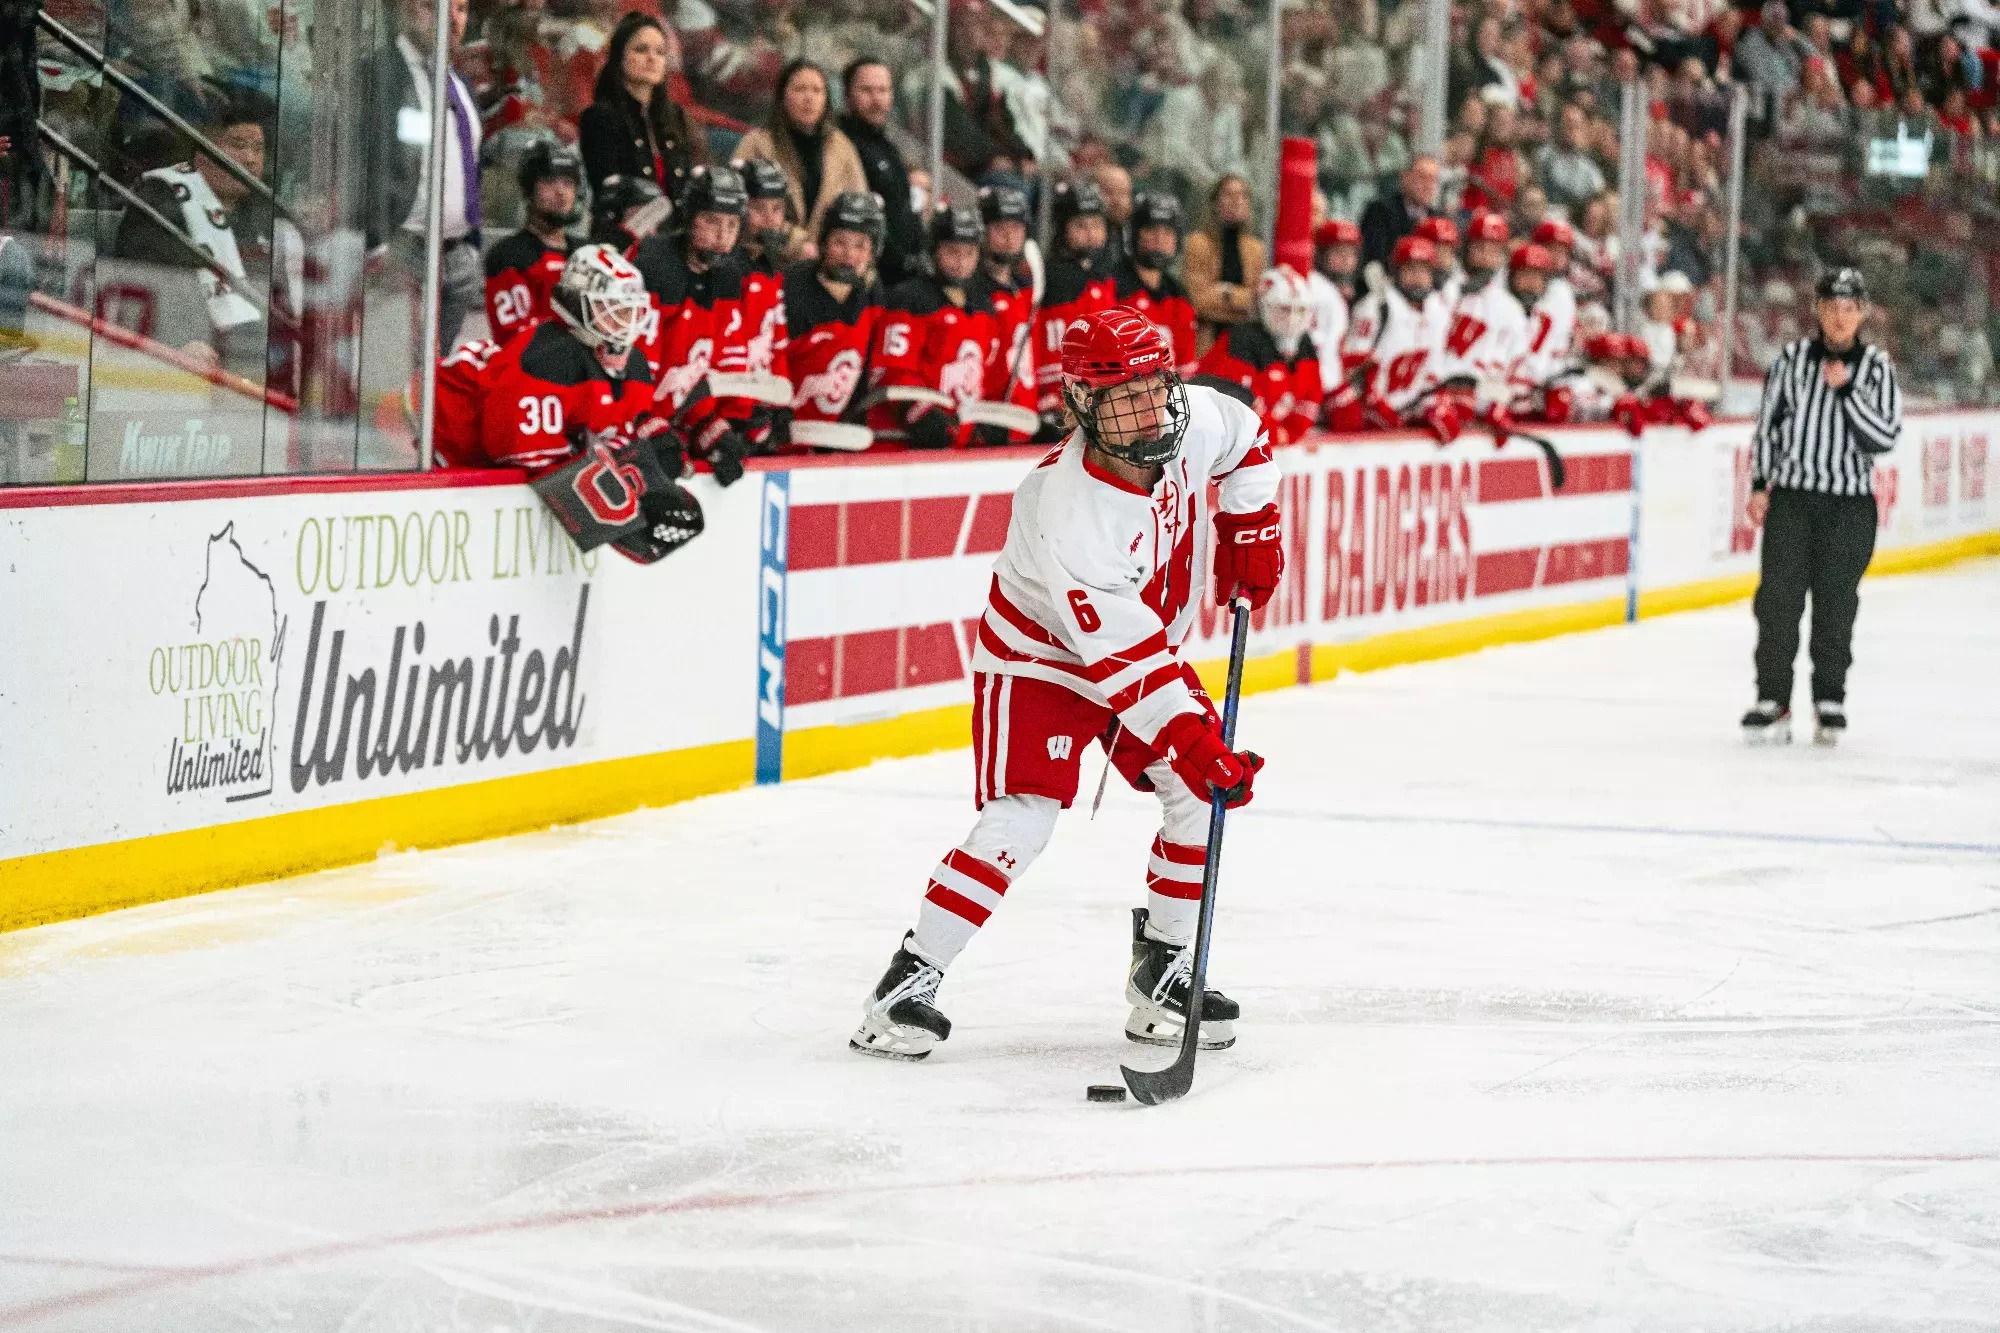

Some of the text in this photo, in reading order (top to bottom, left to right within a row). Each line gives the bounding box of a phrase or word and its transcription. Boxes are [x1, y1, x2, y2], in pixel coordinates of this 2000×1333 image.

[494, 284, 532, 326] 20
[1129, 351, 1160, 366] CCM
[518, 395, 563, 436] 30
[295, 510, 472, 595] OUTDOOR
[1322, 461, 1476, 622] BADGERS
[759, 480, 787, 731] CCM
[1066, 589, 1102, 633] 6
[149, 638, 263, 695] OUTDOOR
[289, 582, 591, 794] Unlimited
[183, 690, 262, 744] LIVING
[166, 727, 266, 796] Unlimited
